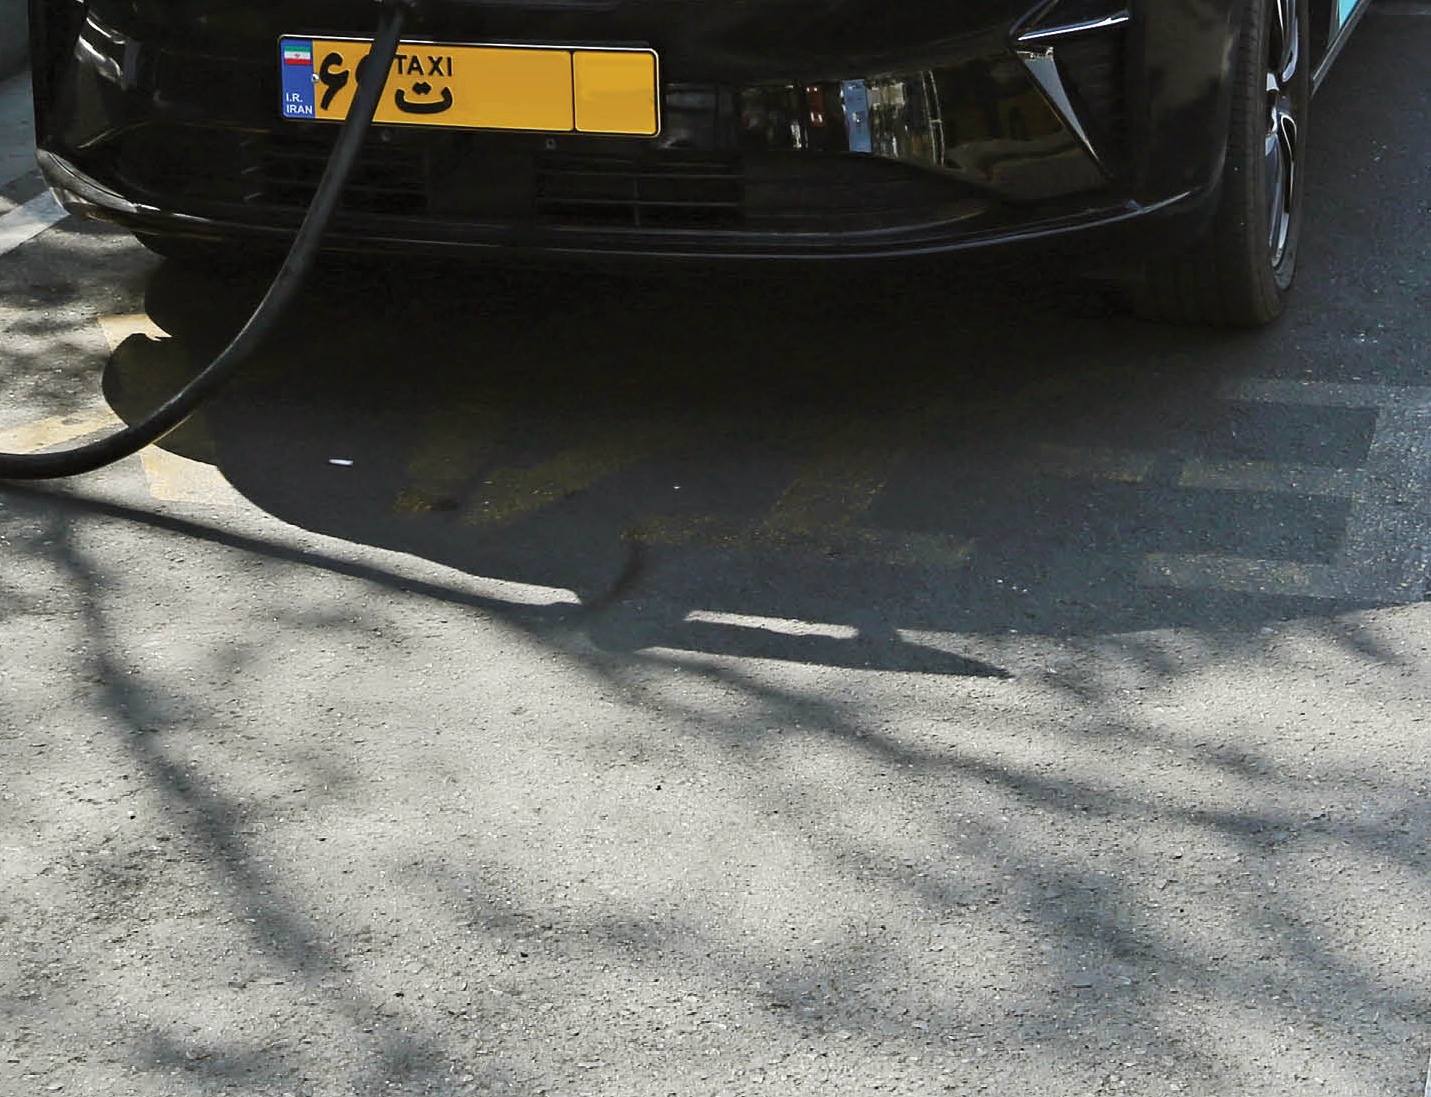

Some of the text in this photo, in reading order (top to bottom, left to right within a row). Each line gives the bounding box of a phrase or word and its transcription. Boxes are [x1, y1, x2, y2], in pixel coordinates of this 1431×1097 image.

[394, 54, 453, 76] TAXI
[286, 92, 303, 103] I.R.
[286, 104, 313, 115] IRAN
